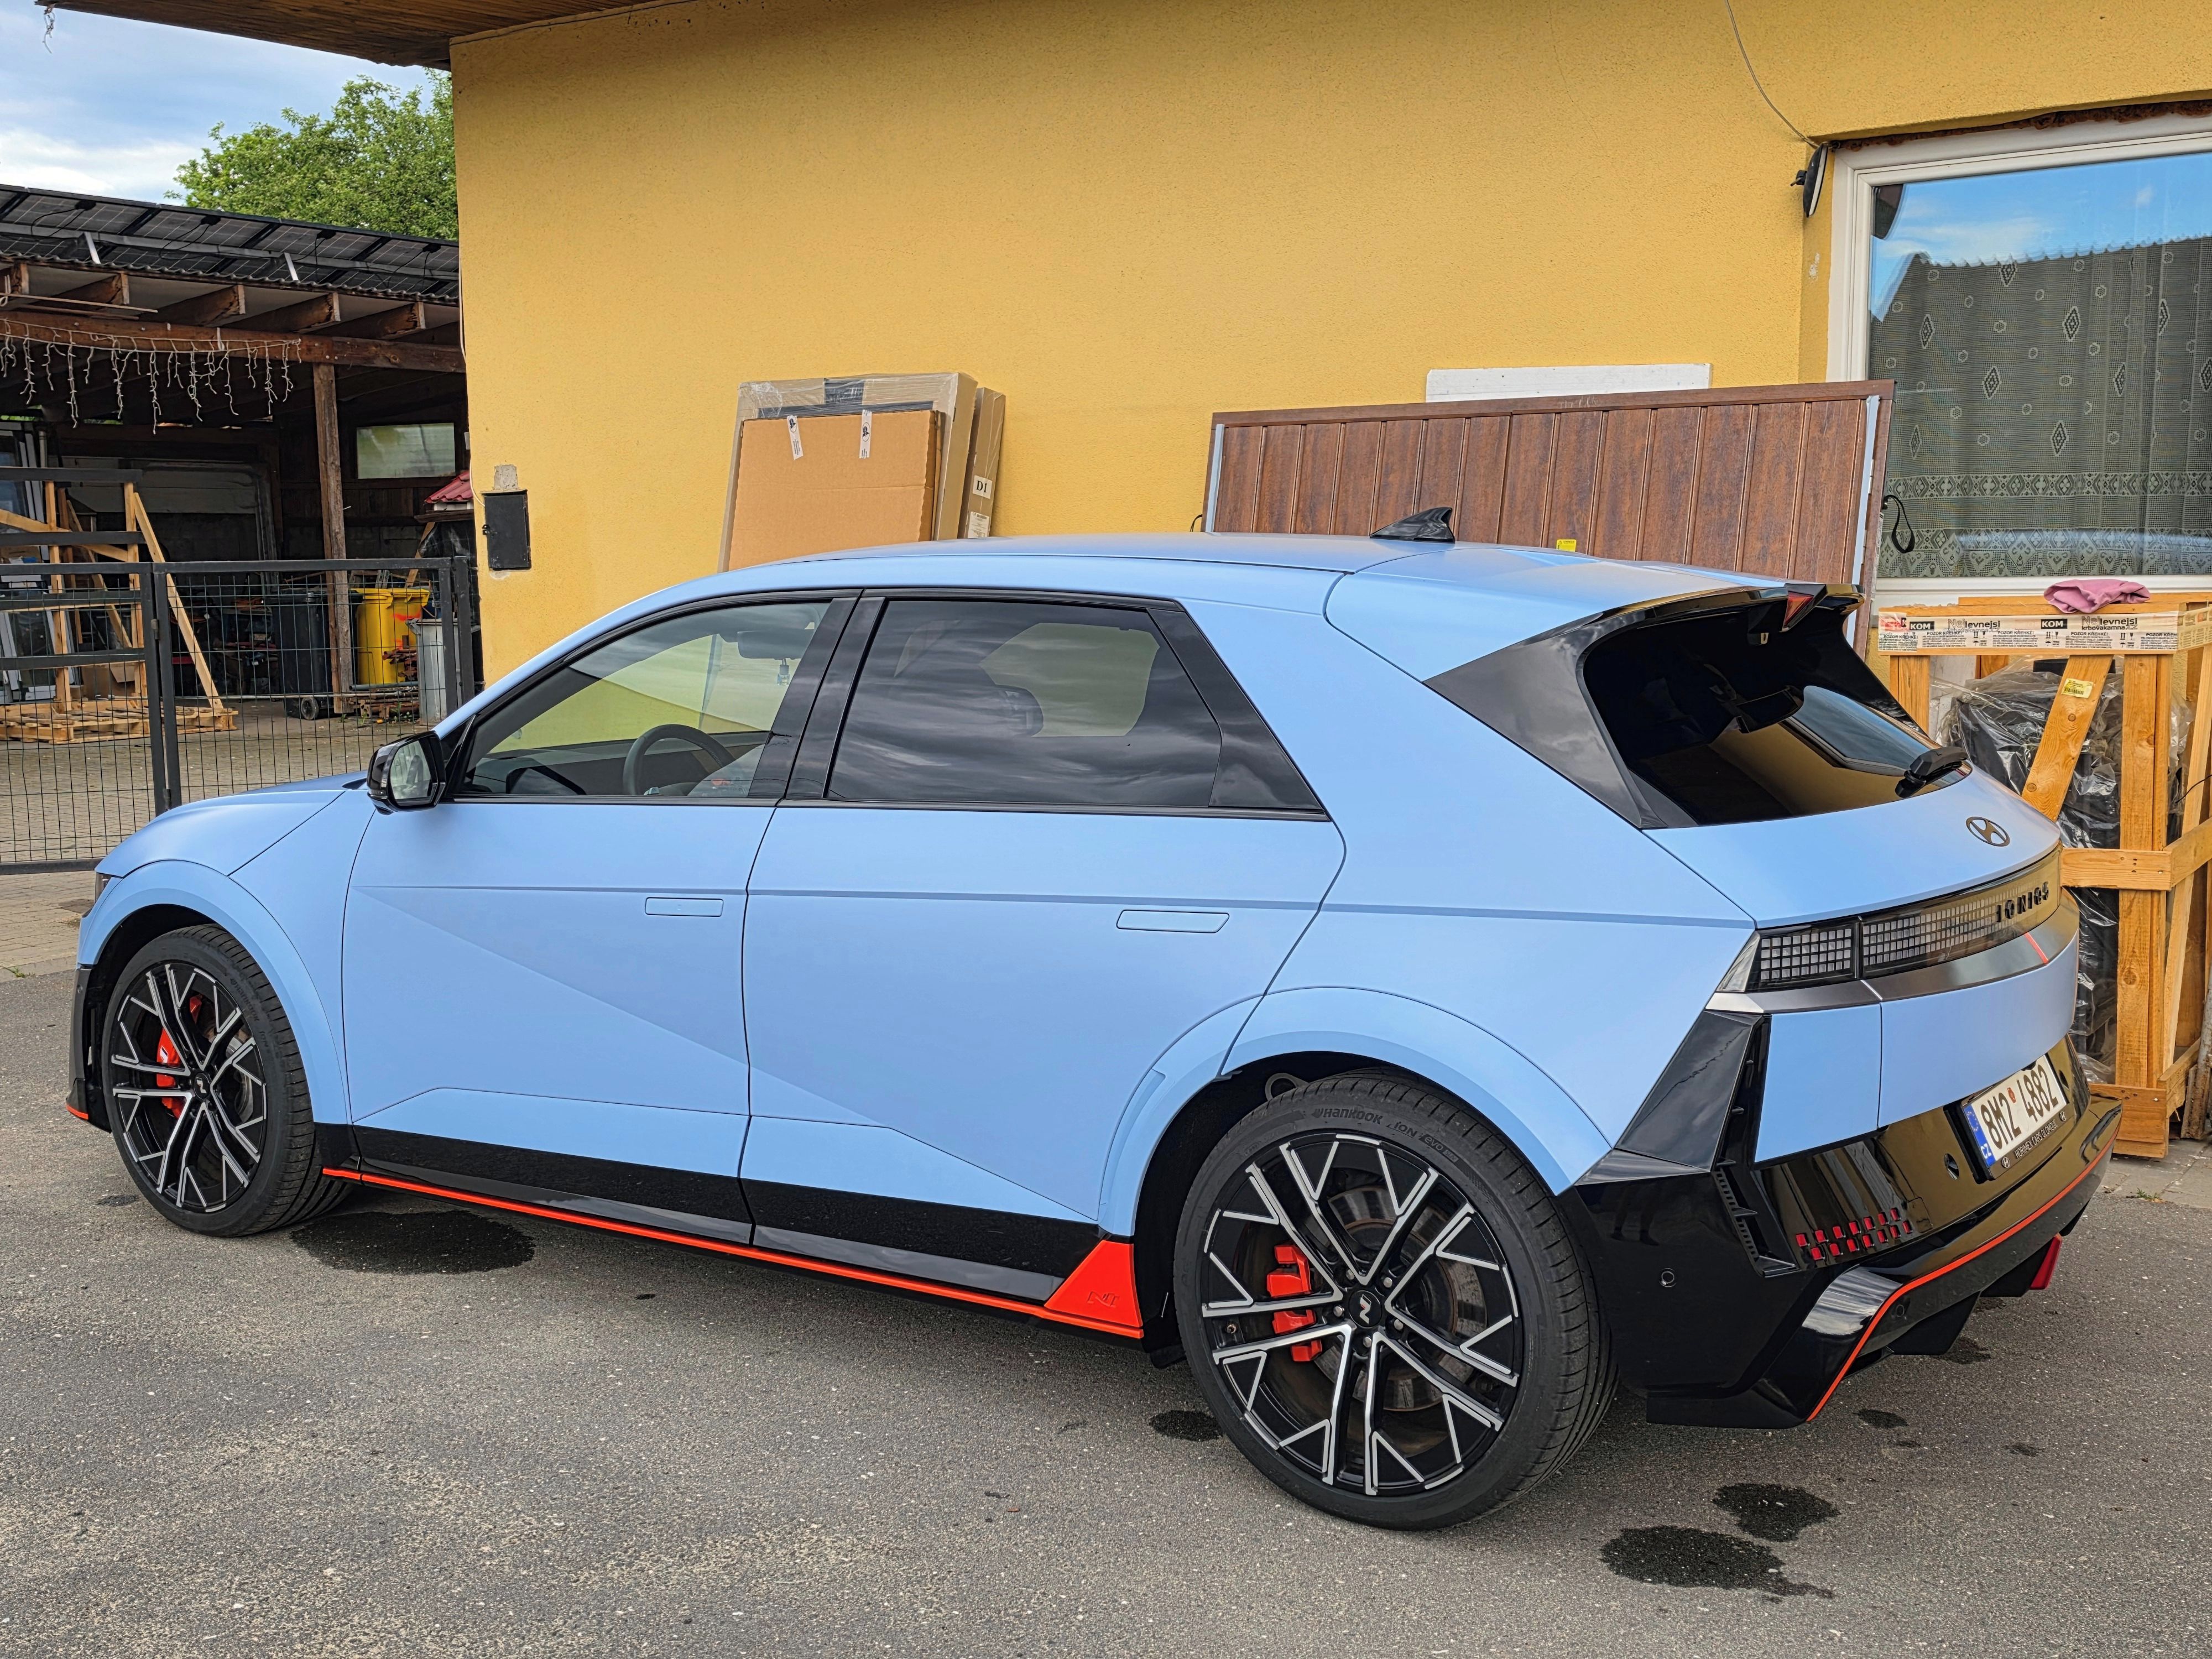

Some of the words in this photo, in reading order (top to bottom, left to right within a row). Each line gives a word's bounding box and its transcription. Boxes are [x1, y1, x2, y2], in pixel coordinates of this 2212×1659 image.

[977, 480, 987, 493] D1
[1980, 1092, 2022, 1150] 8M2
[2017, 1065, 2059, 1122] 4882
[1980, 1143, 1992, 1159] CZ
[2014, 1139, 2034, 1159] HORIMEX
[2032, 1131, 2043, 1145] CARS
